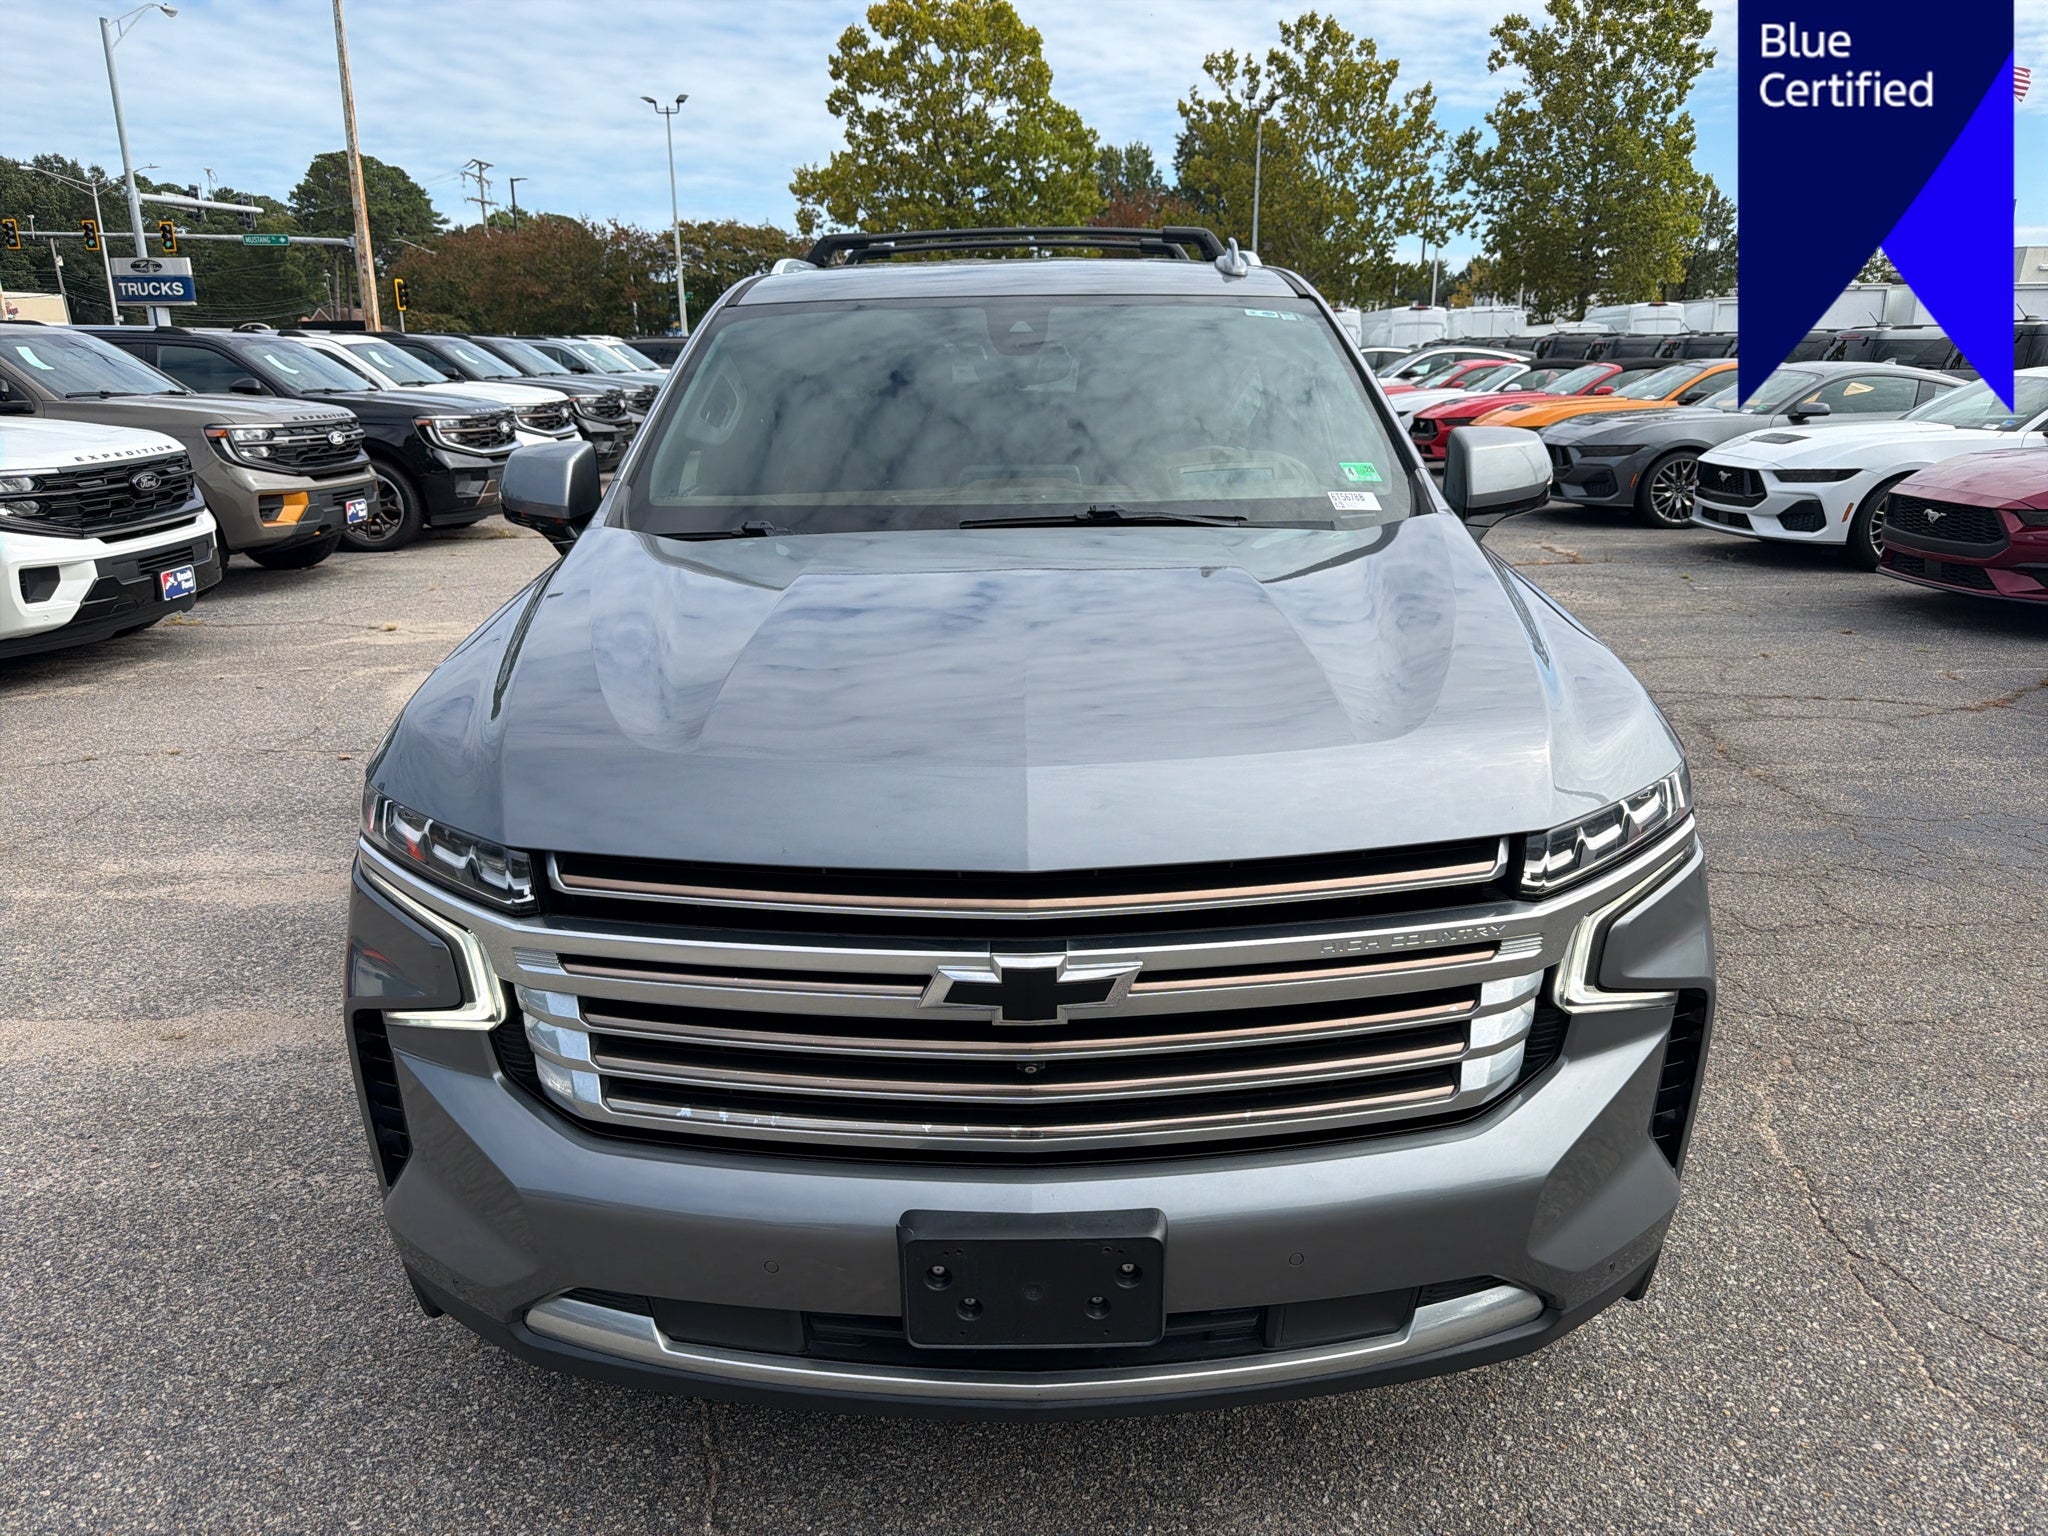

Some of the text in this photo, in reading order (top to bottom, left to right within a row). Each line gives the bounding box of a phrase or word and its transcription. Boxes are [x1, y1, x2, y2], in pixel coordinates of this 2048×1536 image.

[118, 281, 184, 296] TRUCKS
[74, 445, 173, 462] EXPEDITION
[1391, 924, 1506, 946] COUNTRY
